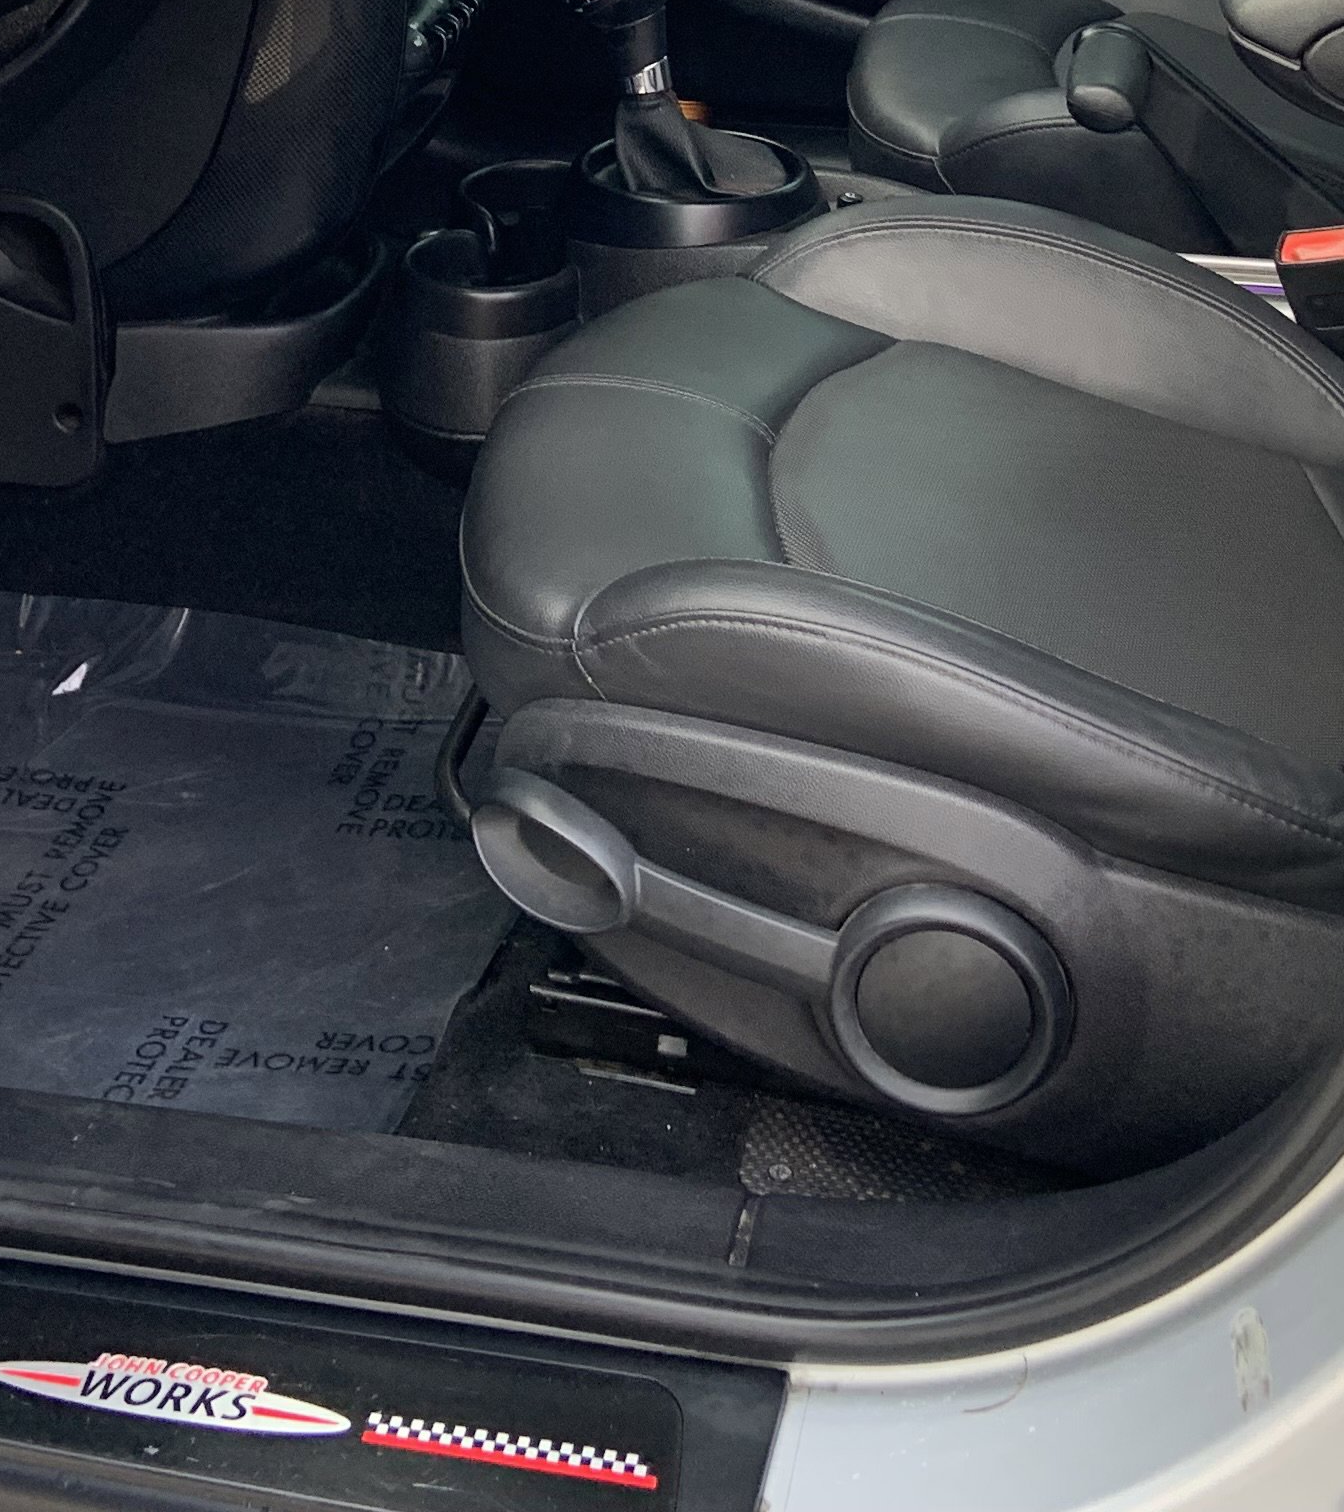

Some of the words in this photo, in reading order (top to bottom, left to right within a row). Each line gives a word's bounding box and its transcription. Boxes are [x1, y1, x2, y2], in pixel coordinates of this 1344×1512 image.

[59, 826, 131, 892] COVER
[155, 1018, 229, 1102] DEALER
[213, 1047, 372, 1077] REMOVE
[314, 1031, 436, 1055] COVER
[79, 1370, 256, 1420] WORKS
[90, 1352, 160, 1376] JOHN
[166, 1361, 267, 1393] COOPER
